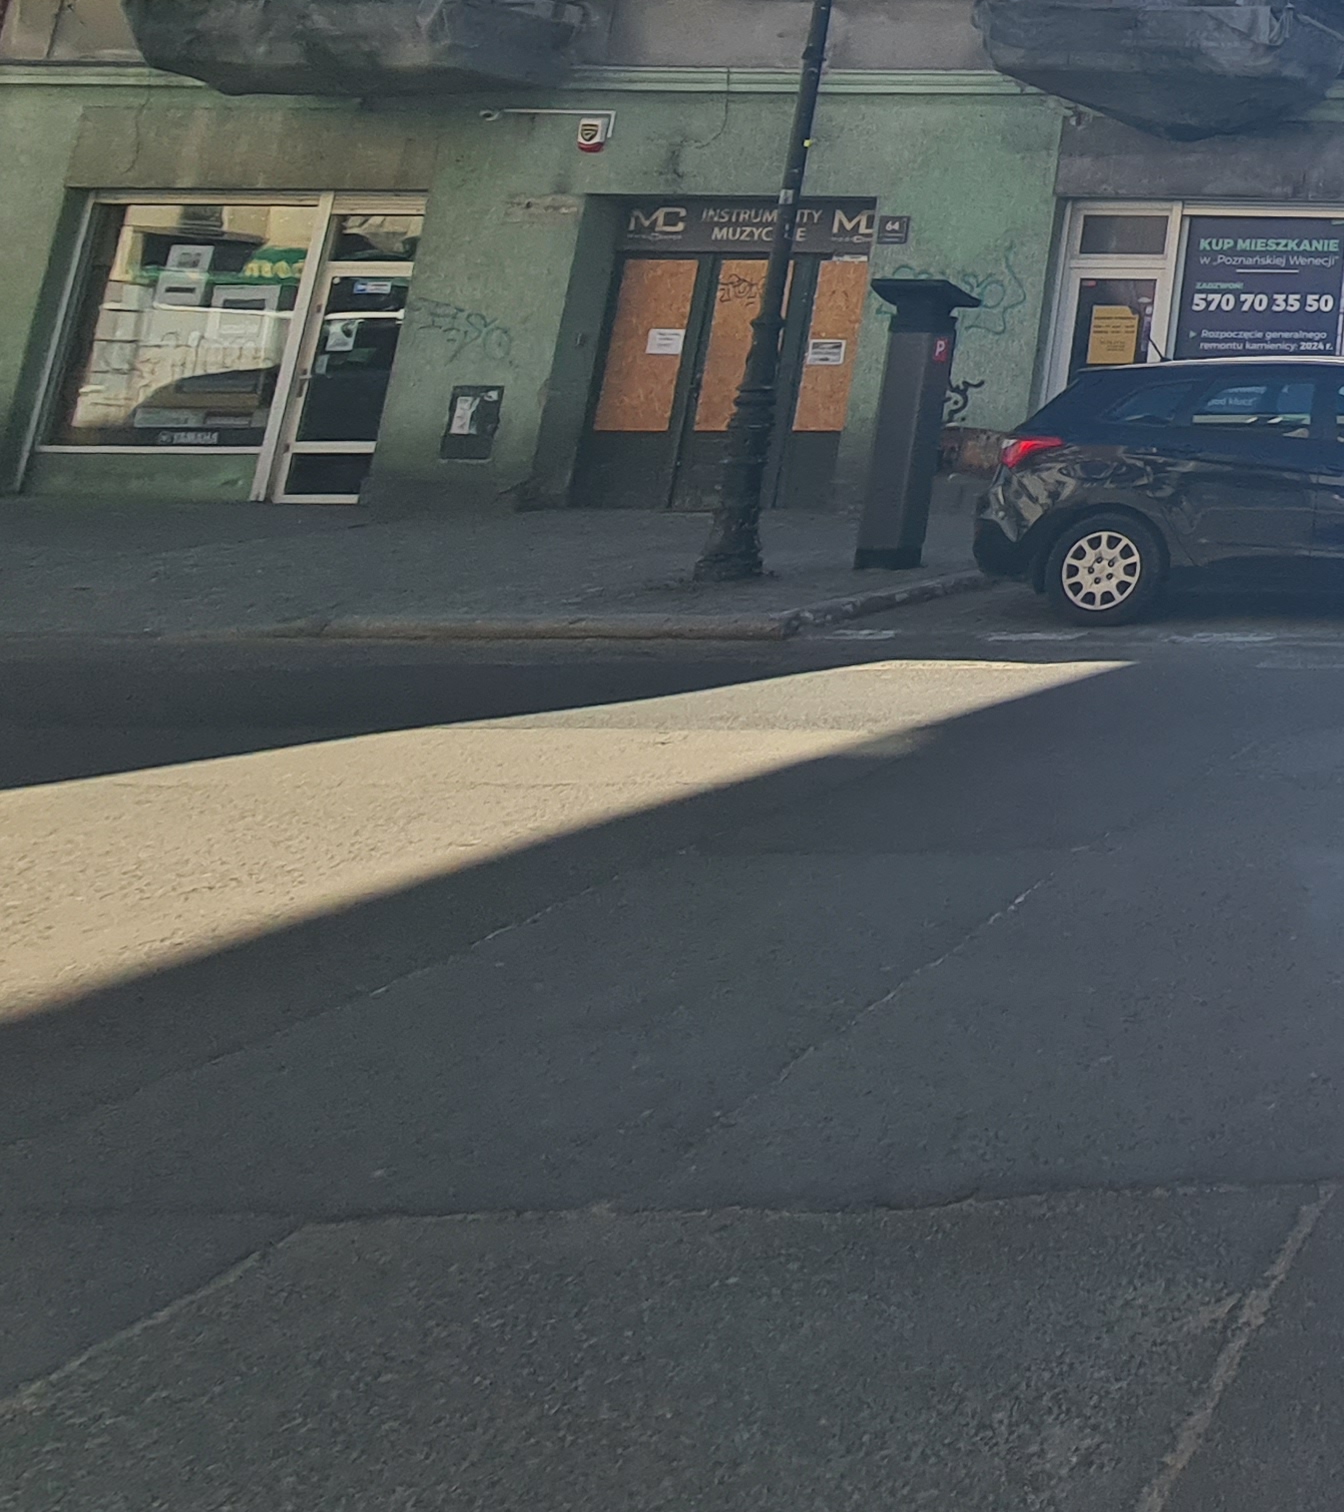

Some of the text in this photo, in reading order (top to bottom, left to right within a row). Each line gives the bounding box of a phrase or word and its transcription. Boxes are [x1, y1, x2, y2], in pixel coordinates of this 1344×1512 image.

[701, 207, 823, 223] INSTRUMTY
[884, 219, 900, 232] 64
[711, 226, 806, 242] MUZYCE
[1199, 238, 1340, 252] KUP MIESZKANIE
[1200, 256, 1210, 264] w
[1191, 293, 1335, 313] 570 70 35 50
[1200, 329, 1328, 341] Rozpoczęcie generalnego
[935, 339, 946, 355] P
[1199, 341, 1244, 351] remontu
[1299, 341, 1325, 351] 2024
